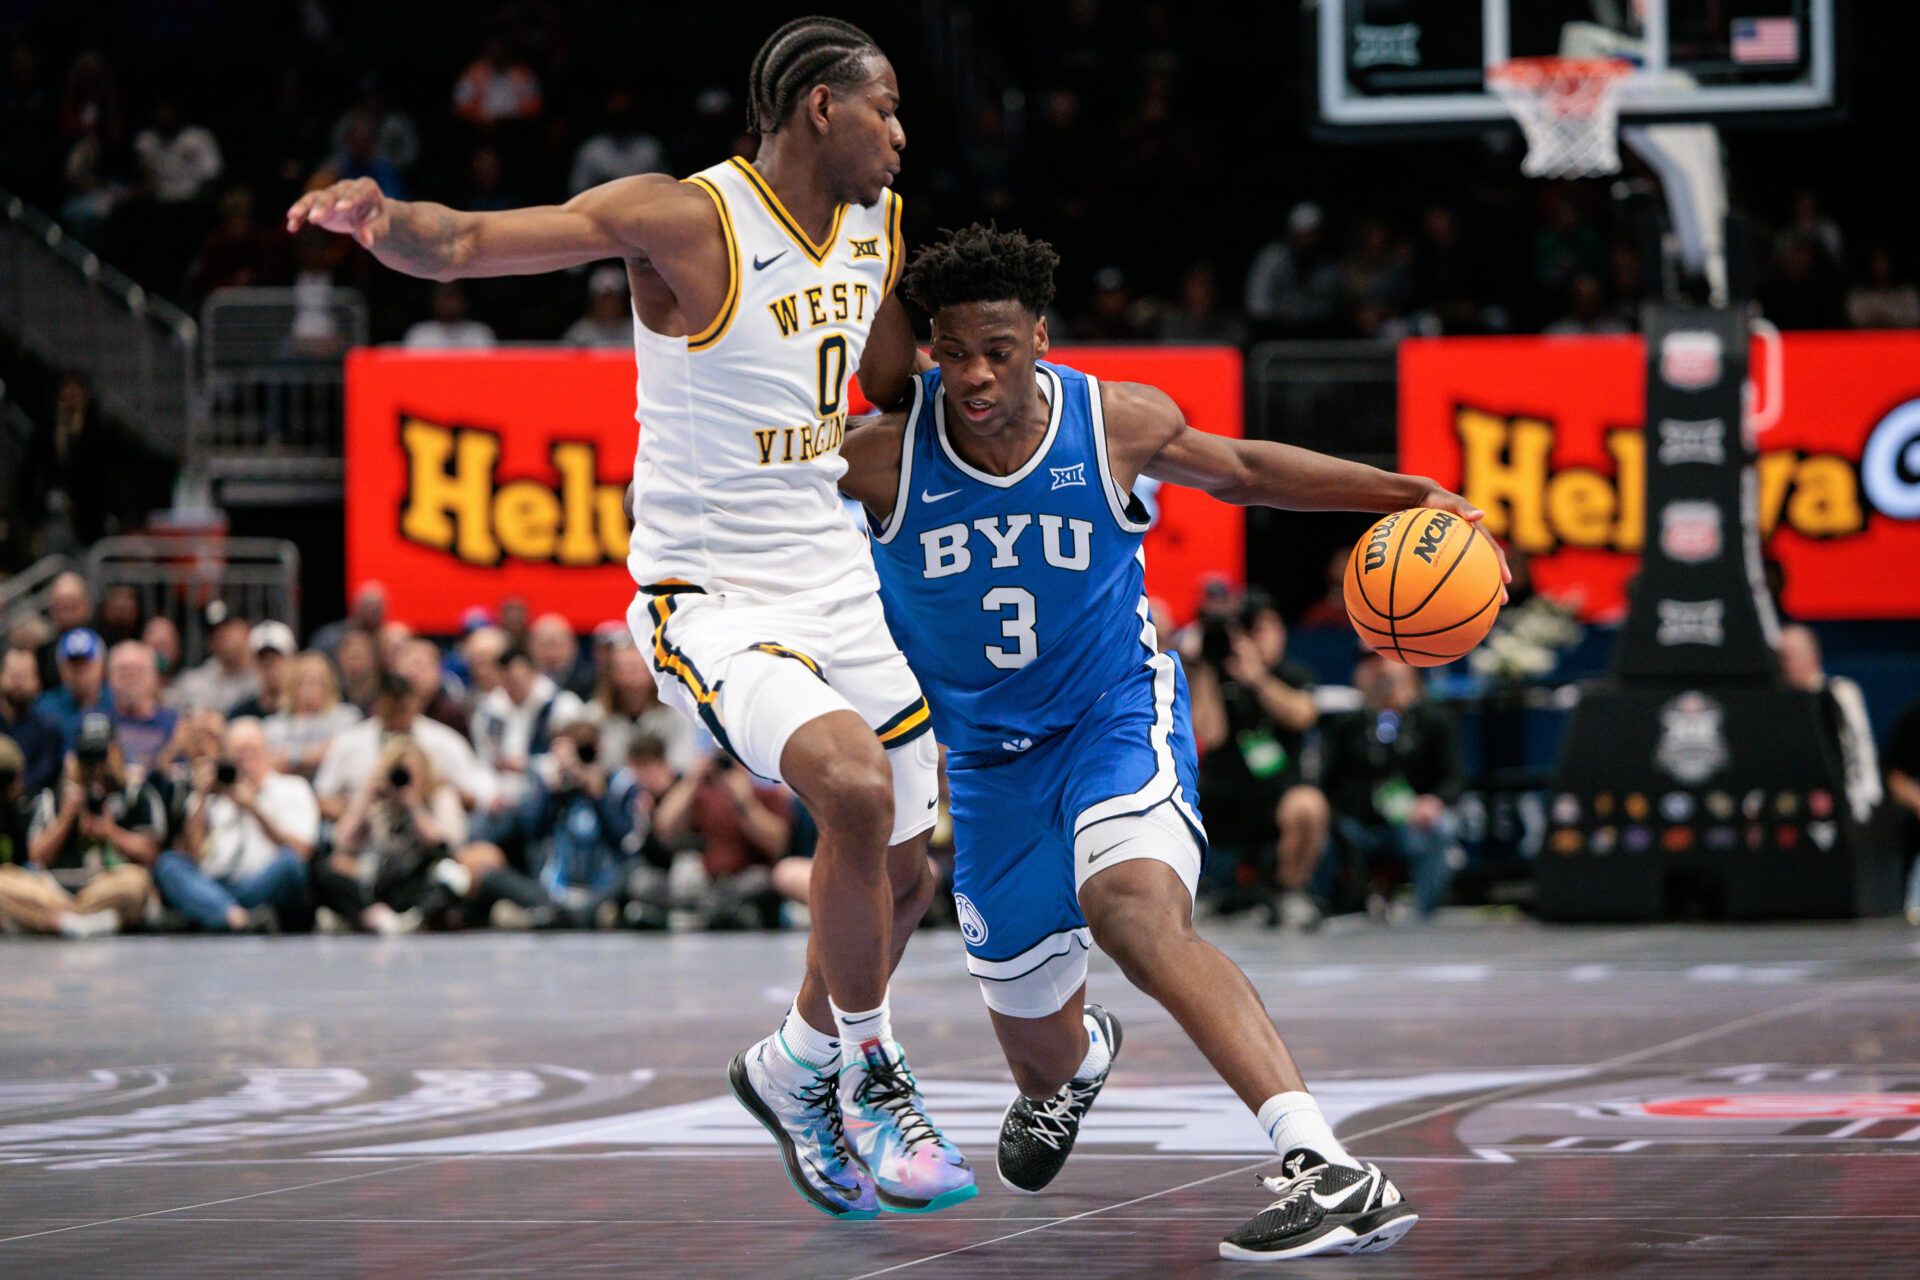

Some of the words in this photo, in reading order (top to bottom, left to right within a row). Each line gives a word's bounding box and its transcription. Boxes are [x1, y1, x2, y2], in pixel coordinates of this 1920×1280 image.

[847, 236, 882, 260] XII
[767, 283, 869, 340] WEST
[816, 331, 849, 420] 0
[1050, 462, 1087, 490] XII
[919, 513, 1094, 579] BYU
[1364, 510, 1408, 576] Wils
[1413, 512, 1458, 565] NCAA
[982, 586, 1038, 670] 3
